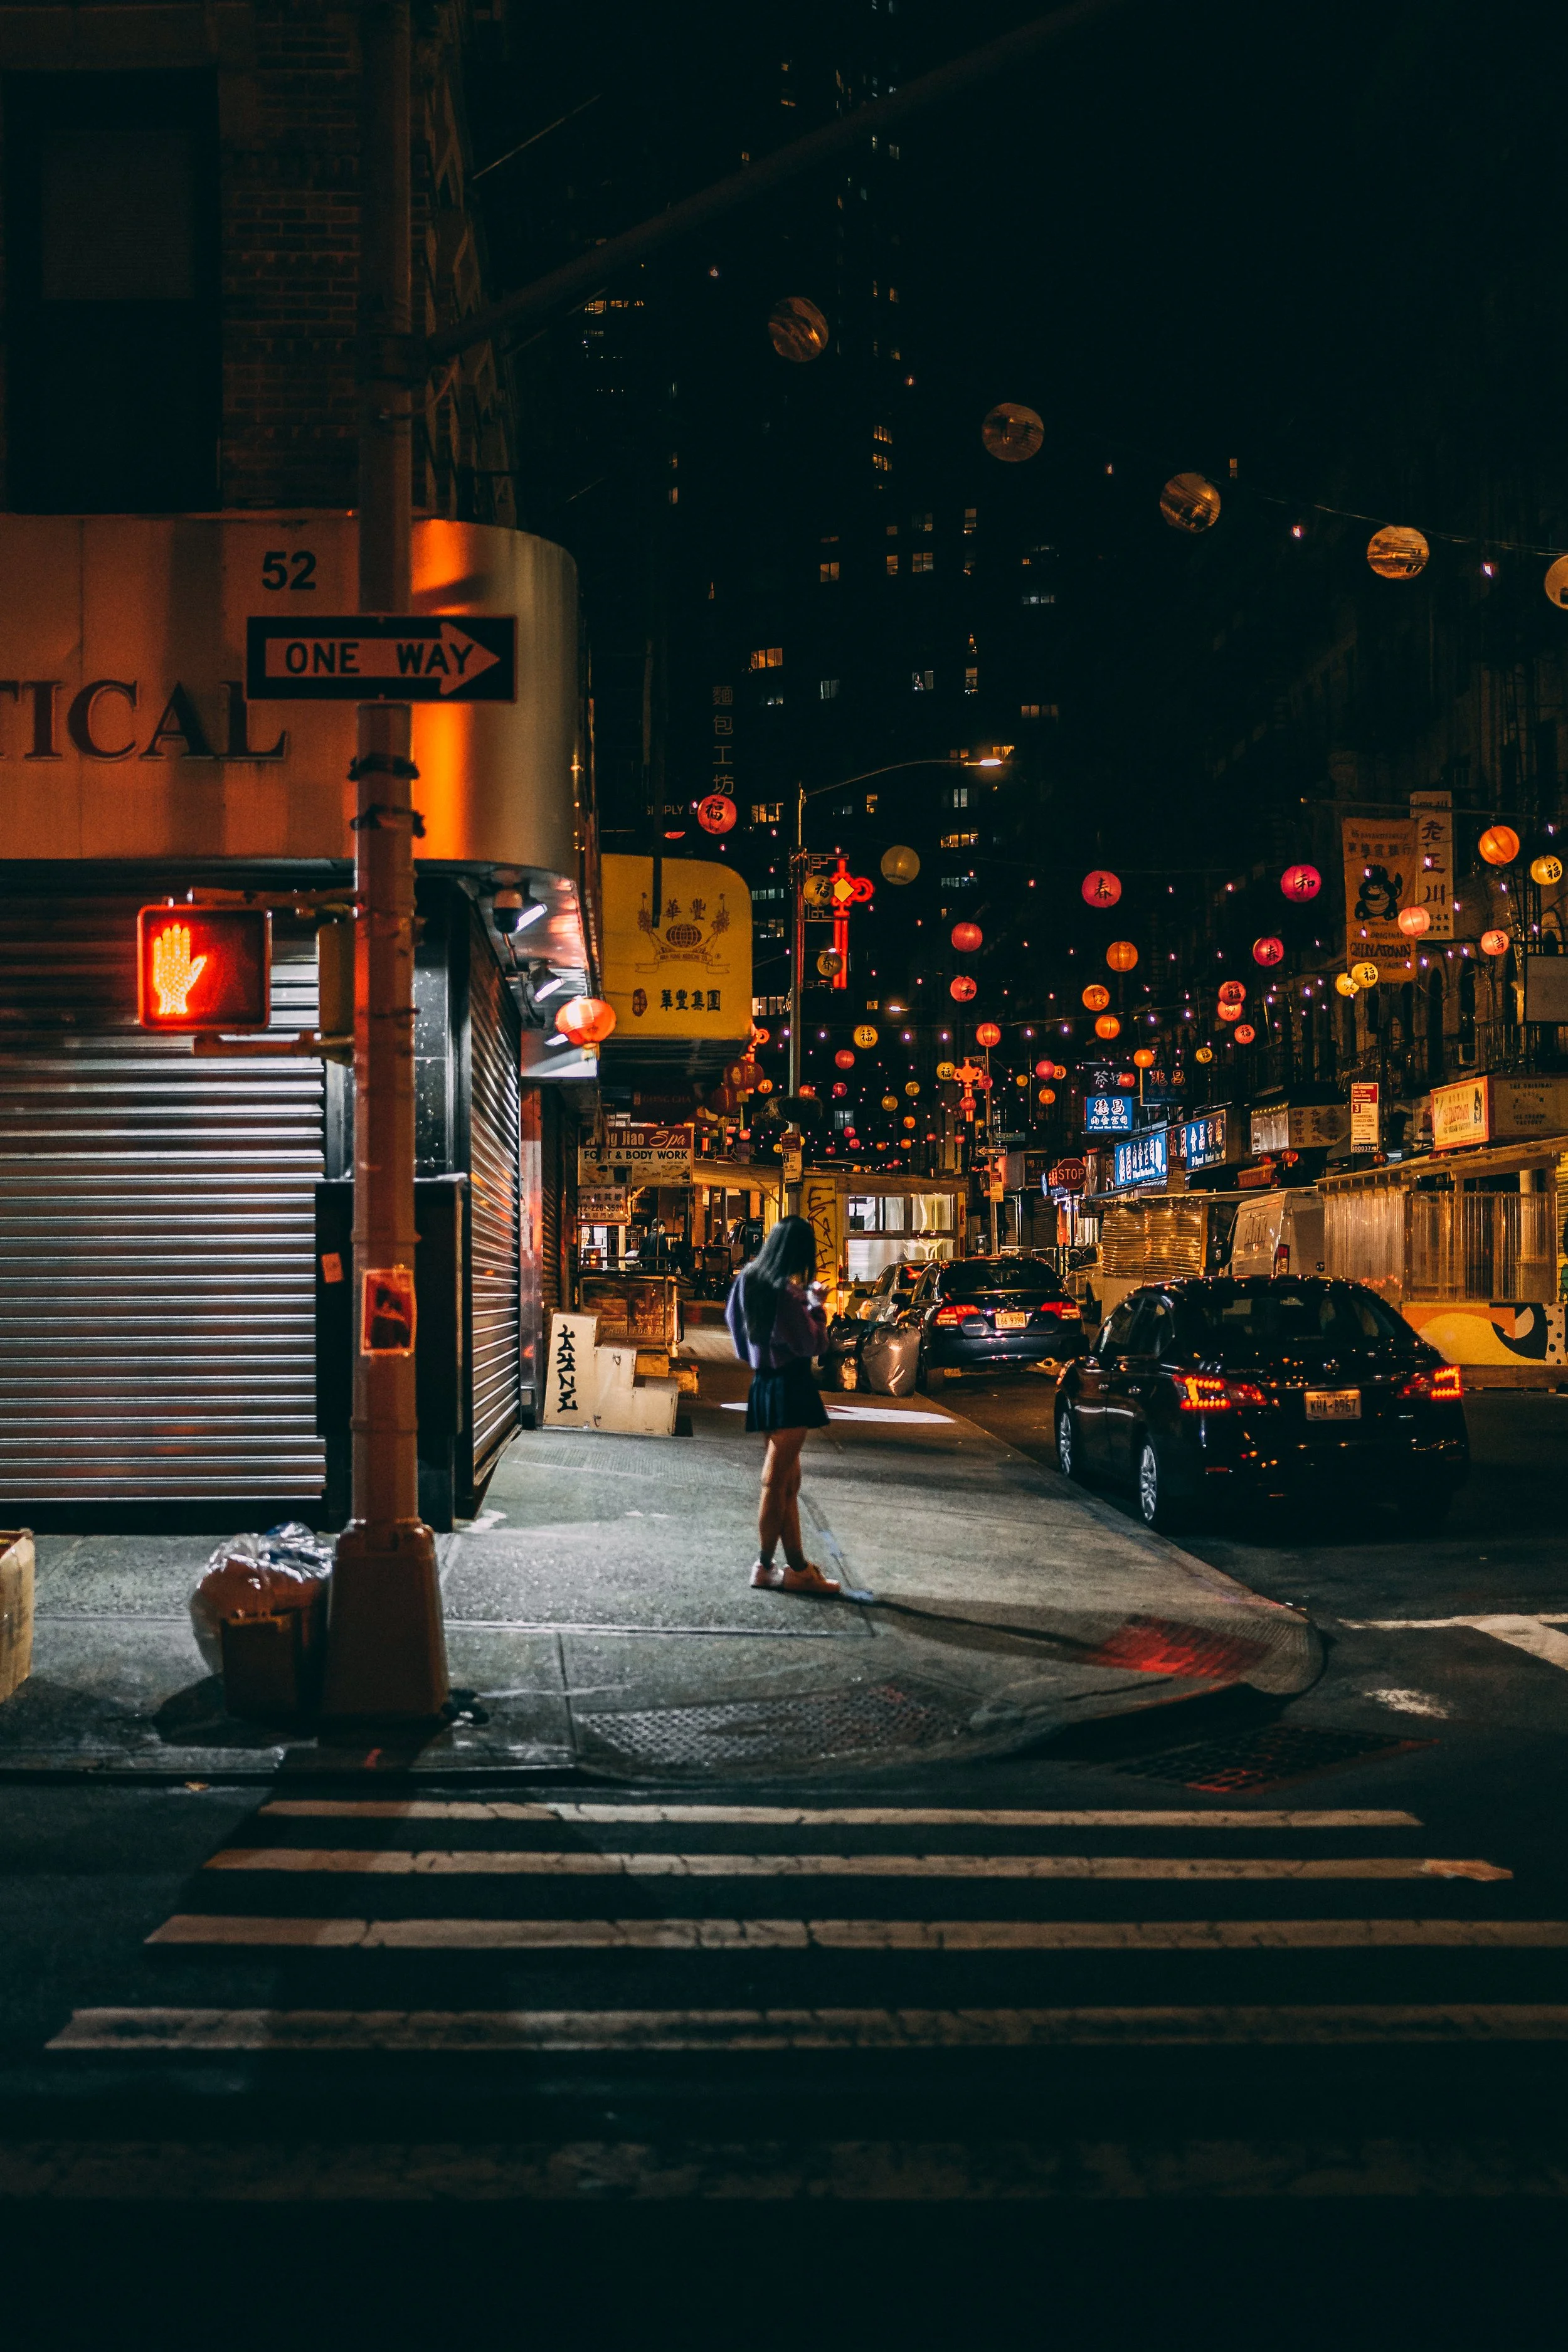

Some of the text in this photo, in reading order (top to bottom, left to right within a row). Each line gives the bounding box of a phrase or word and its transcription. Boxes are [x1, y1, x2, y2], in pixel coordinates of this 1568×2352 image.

[262, 551, 317, 591] 52
[285, 642, 474, 675] ONE WAY
[0, 679, 290, 761] ICAL
[712, 685, 734, 795] 麵包工坊
[706, 798, 725, 821] 福
[1547, 862, 1561, 879] 福
[815, 879, 830, 898] 福
[1094, 877, 1113, 900] 春
[1295, 873, 1316, 891] 和
[1493, 934, 1505, 949] 吉
[1266, 945, 1278, 961] 春
[822, 956, 834, 970] 春
[1364, 967, 1376, 981] 福
[660, 988, 721, 1012] 華豐集團
[1228, 985, 1241, 999] 福
[861, 1029, 873, 1042] 福
[1240, 1027, 1251, 1038] 福
[941, 1067, 951, 1078] 福
[1093, 1098, 1125, 1116] 德昌
[1354, 1104, 1360, 1113] 3
[622, 1130, 645, 1146] Jiao
[649, 1130, 687, 1150] Spa
[584, 1150, 612, 1160] FOT
[615, 1150, 622, 1160] &
[626, 1150, 654, 1160] BODY
[657, 1150, 688, 1160] WORK
[1057, 1168, 1085, 1180] STOP
[753, 1234, 760, 1244] P
[1310, 1399, 1328, 1412] KHA
